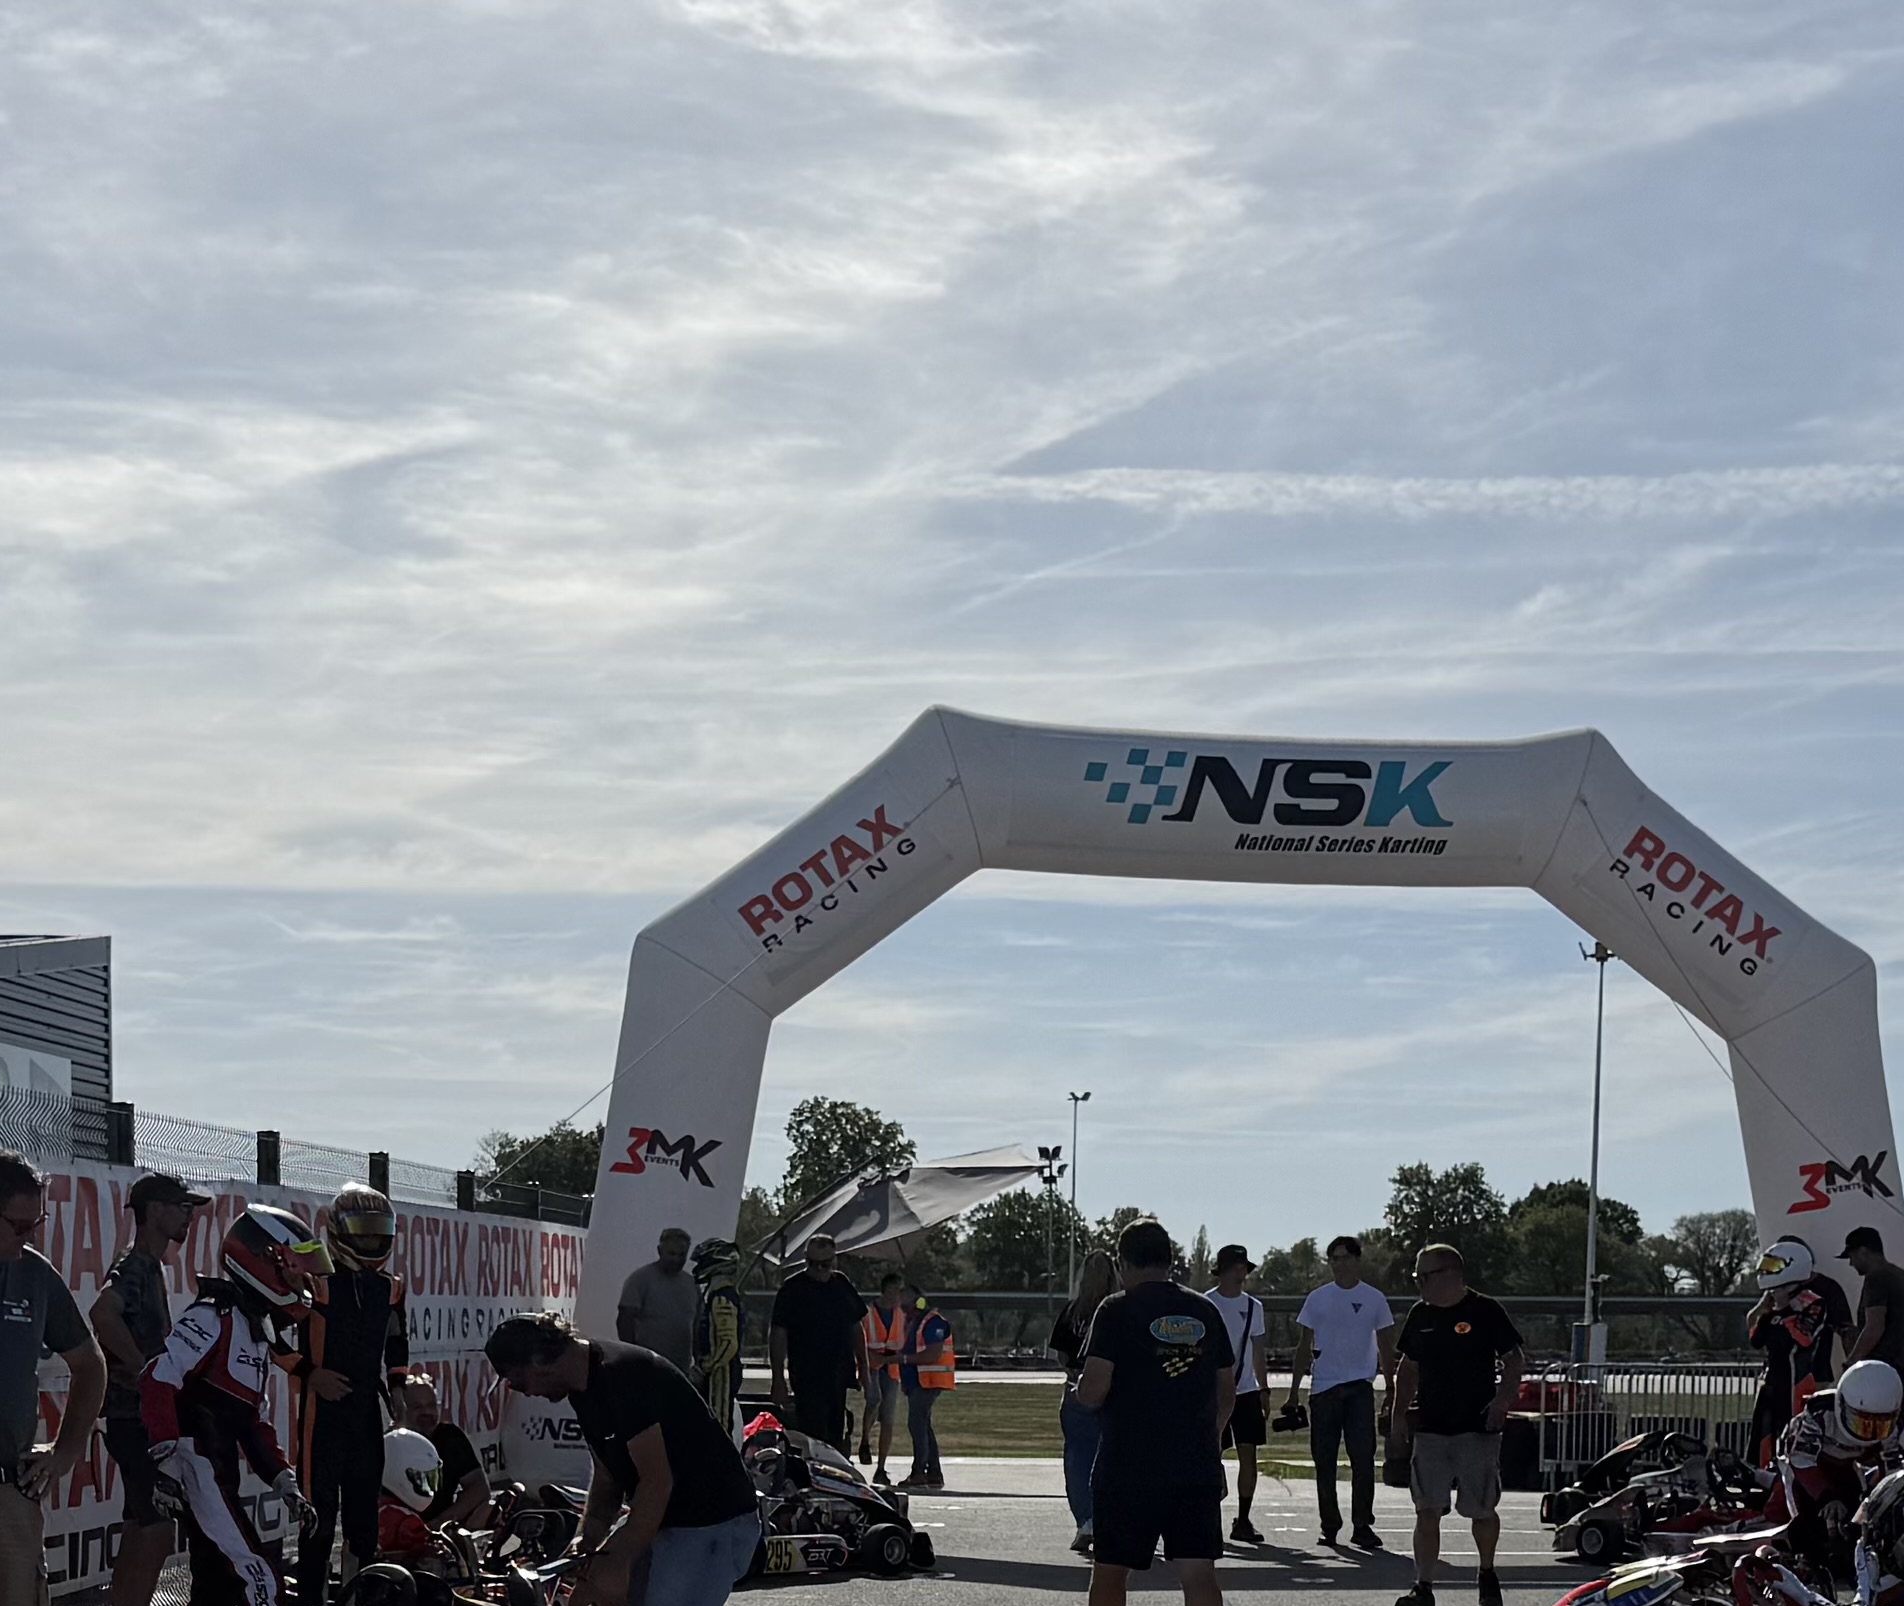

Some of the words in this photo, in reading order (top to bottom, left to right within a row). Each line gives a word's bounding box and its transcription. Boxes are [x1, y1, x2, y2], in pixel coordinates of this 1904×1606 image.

[1161, 754, 1454, 828] NSK
[737, 803, 905, 937] ROTAX
[1234, 832, 1312, 853] National
[1316, 835, 1376, 854] Series
[1378, 836, 1448, 857] Karting
[761, 837, 917, 953] RACING
[1609, 857, 1759, 976] RACING
[1622, 824, 1783, 961] ROTAX
[609, 1127, 723, 1189] 3MK
[644, 1154, 680, 1168] EVENTS
[1786, 1150, 1895, 1215] 3MK
[393, 1213, 470, 1297] ROTAX
[477, 1223, 535, 1298] ROTAX
[408, 1306, 470, 1341] ACING
[537, 1418, 585, 1441] NS
